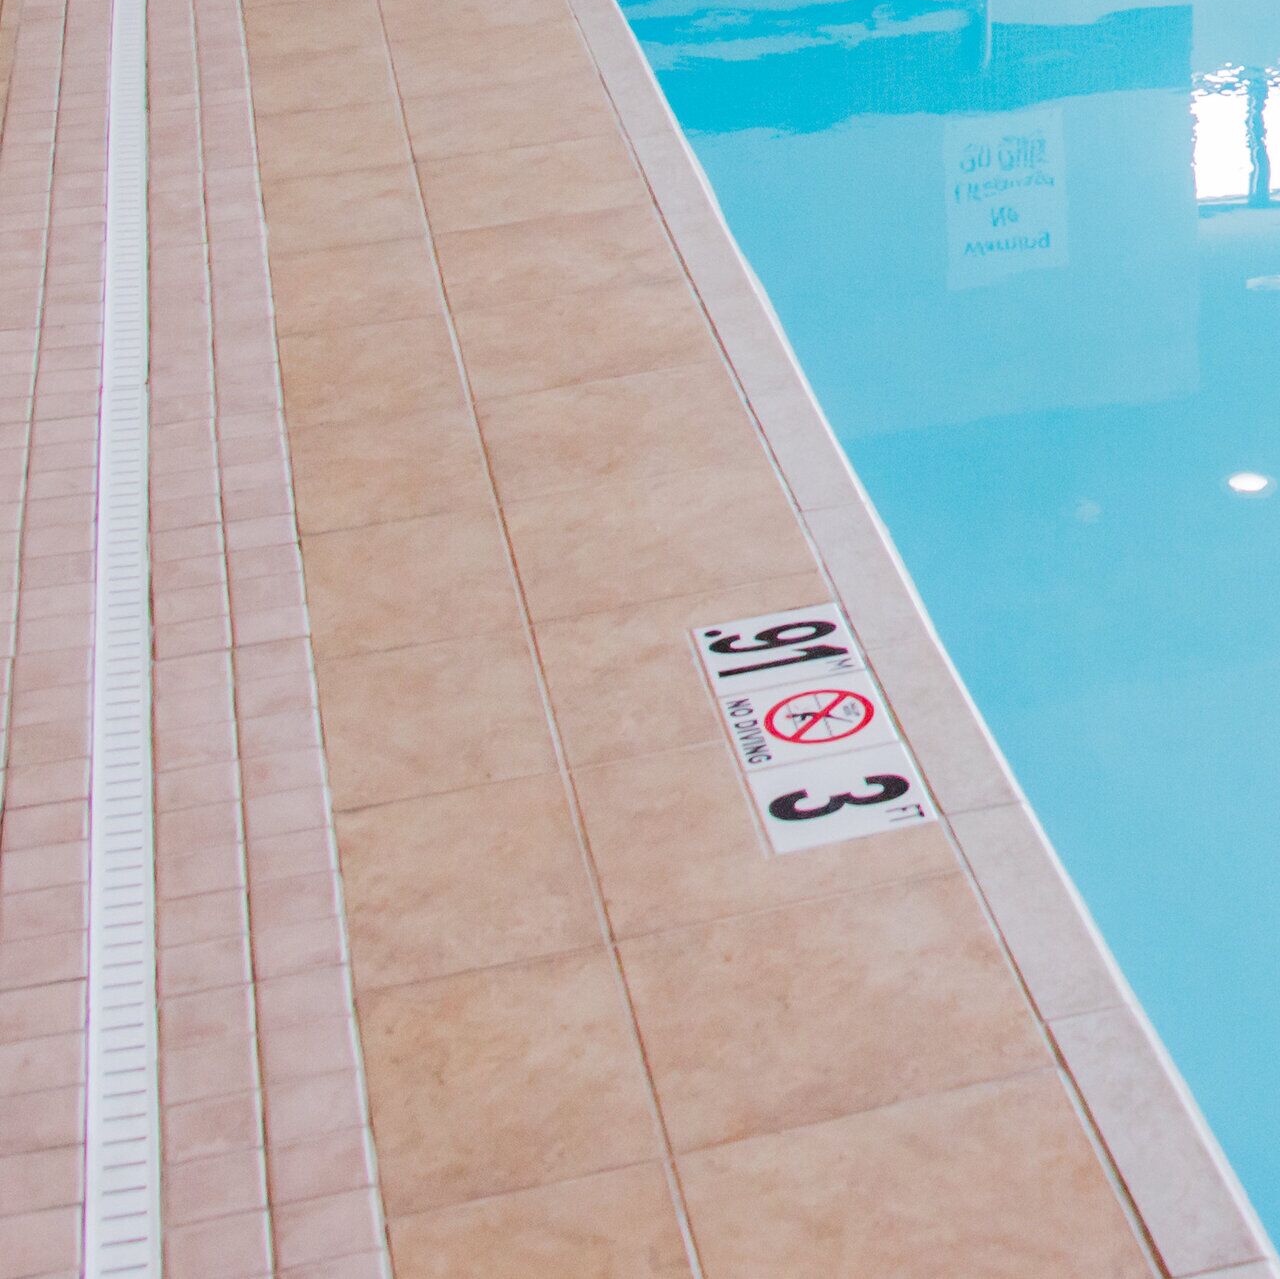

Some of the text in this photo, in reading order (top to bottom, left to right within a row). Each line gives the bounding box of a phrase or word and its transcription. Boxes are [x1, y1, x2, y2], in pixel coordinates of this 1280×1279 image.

[726, 699, 772, 763] NO DIVING
[769, 774, 910, 821] 3
